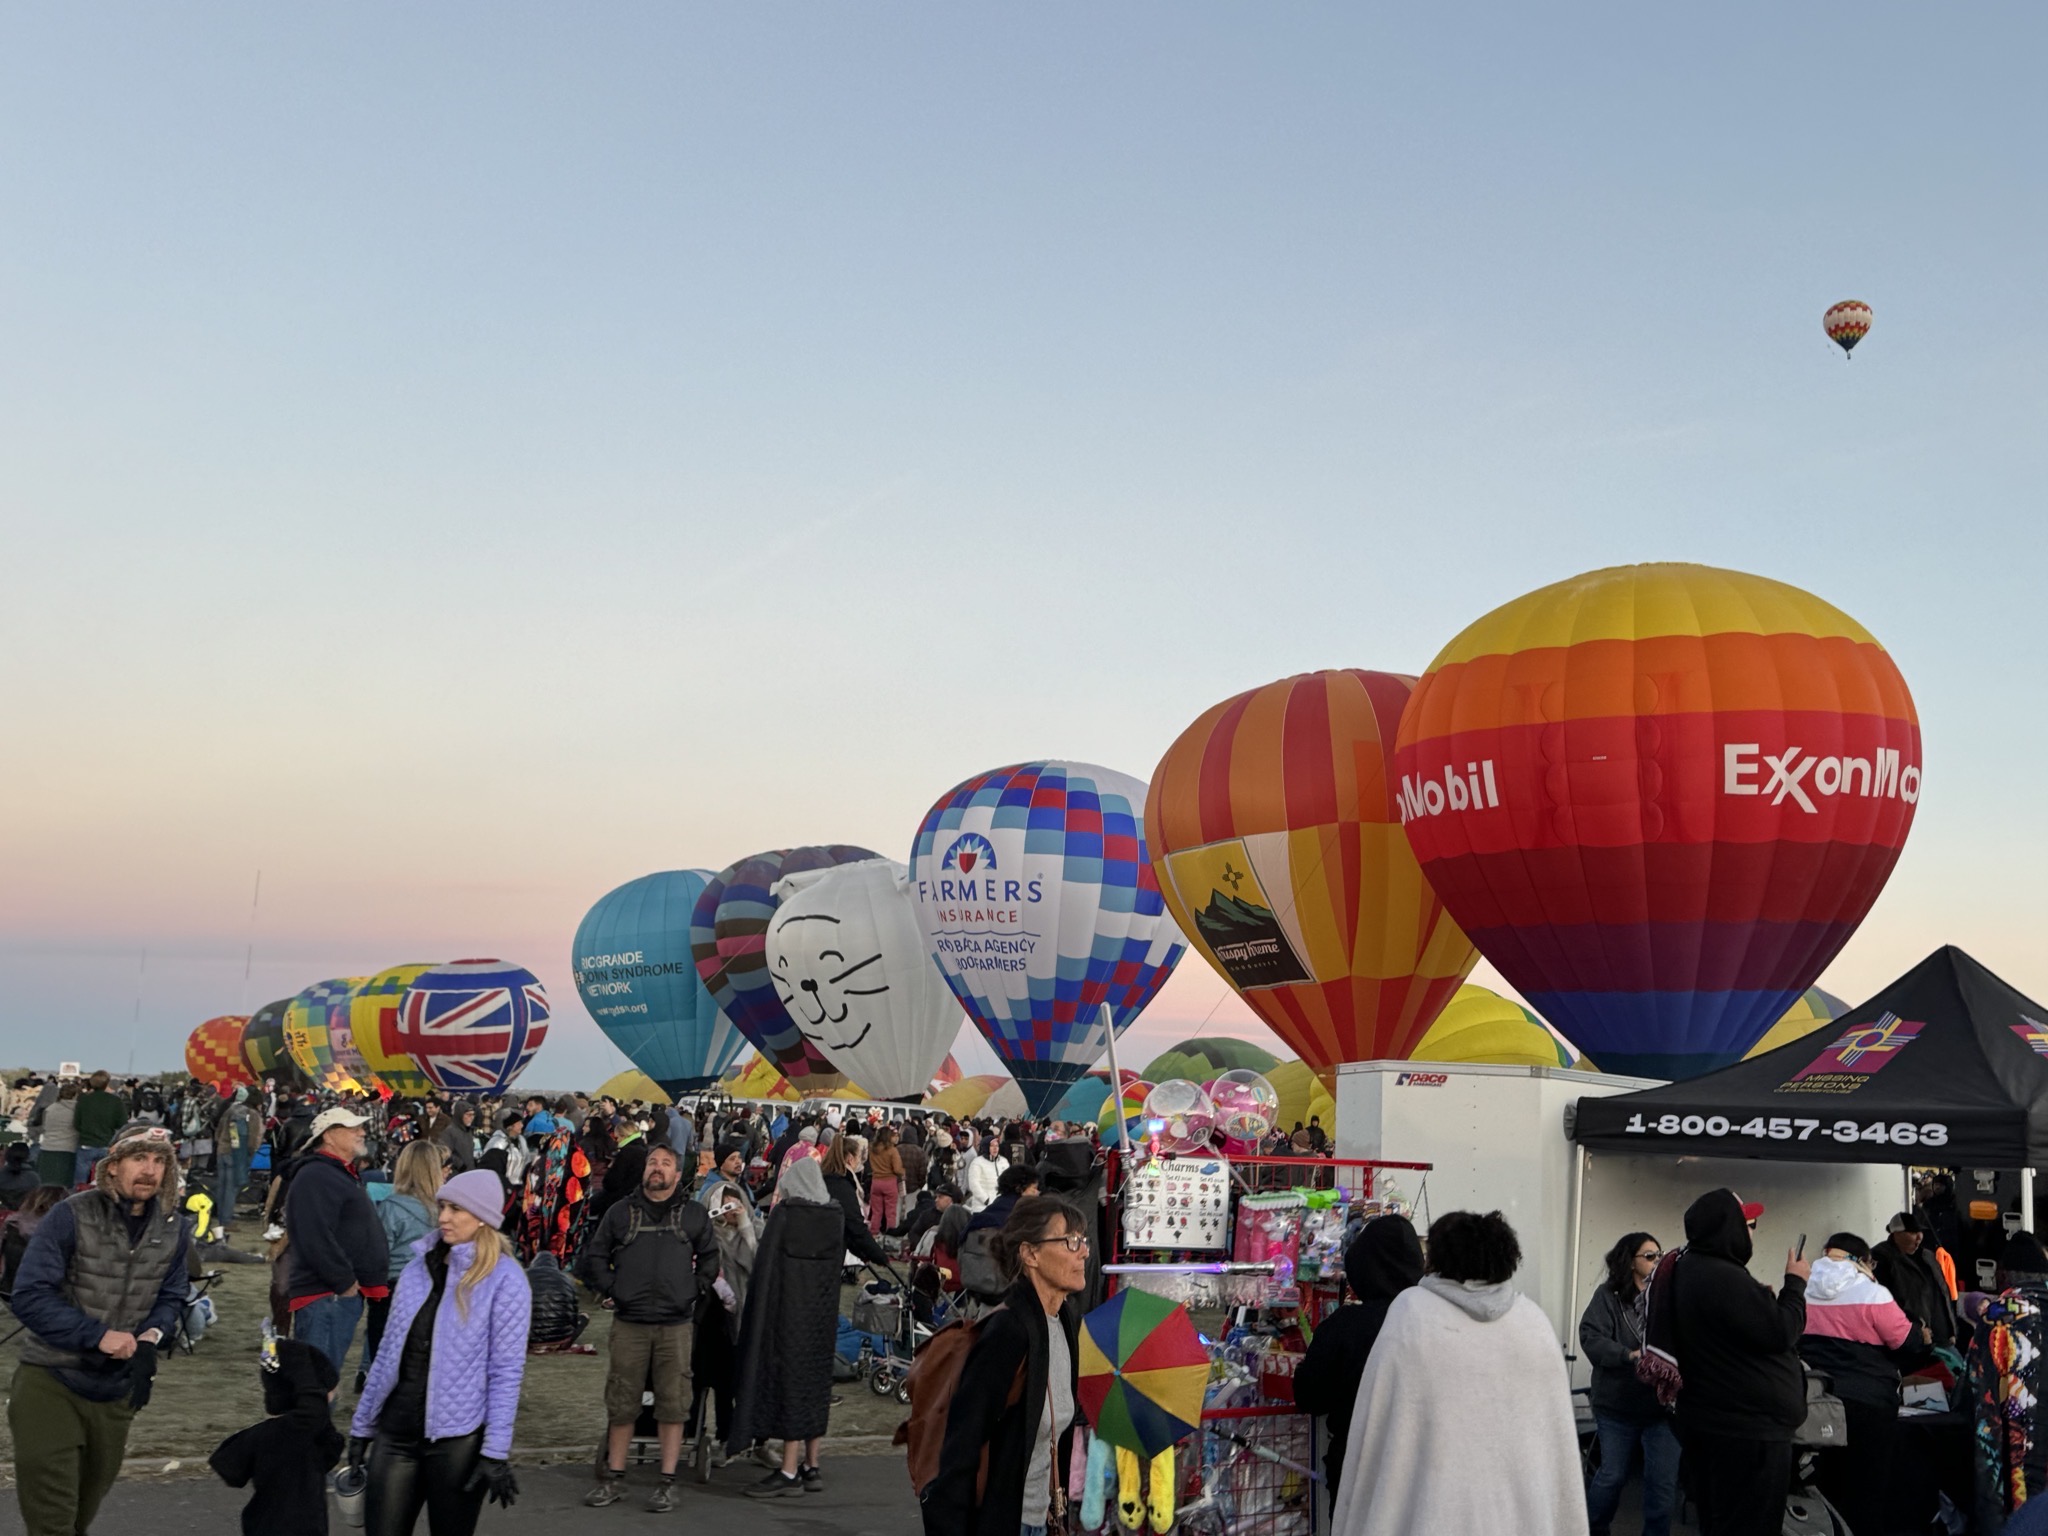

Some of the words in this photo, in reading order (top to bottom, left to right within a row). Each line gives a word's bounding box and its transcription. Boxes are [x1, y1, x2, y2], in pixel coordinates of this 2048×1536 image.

[918, 878, 1042, 904] FARMERS
[984, 938, 1036, 955] AGENCY
[595, 951, 644, 968] GRANDE
[611, 962, 683, 980] SYNDROME
[1780, 1082, 1862, 1090] PERSONS
[1805, 1074, 1870, 1083] MISSING
[1625, 1112, 1949, 1147] 1-800-457-3463
[1161, 1160, 1199, 1174] Charms
